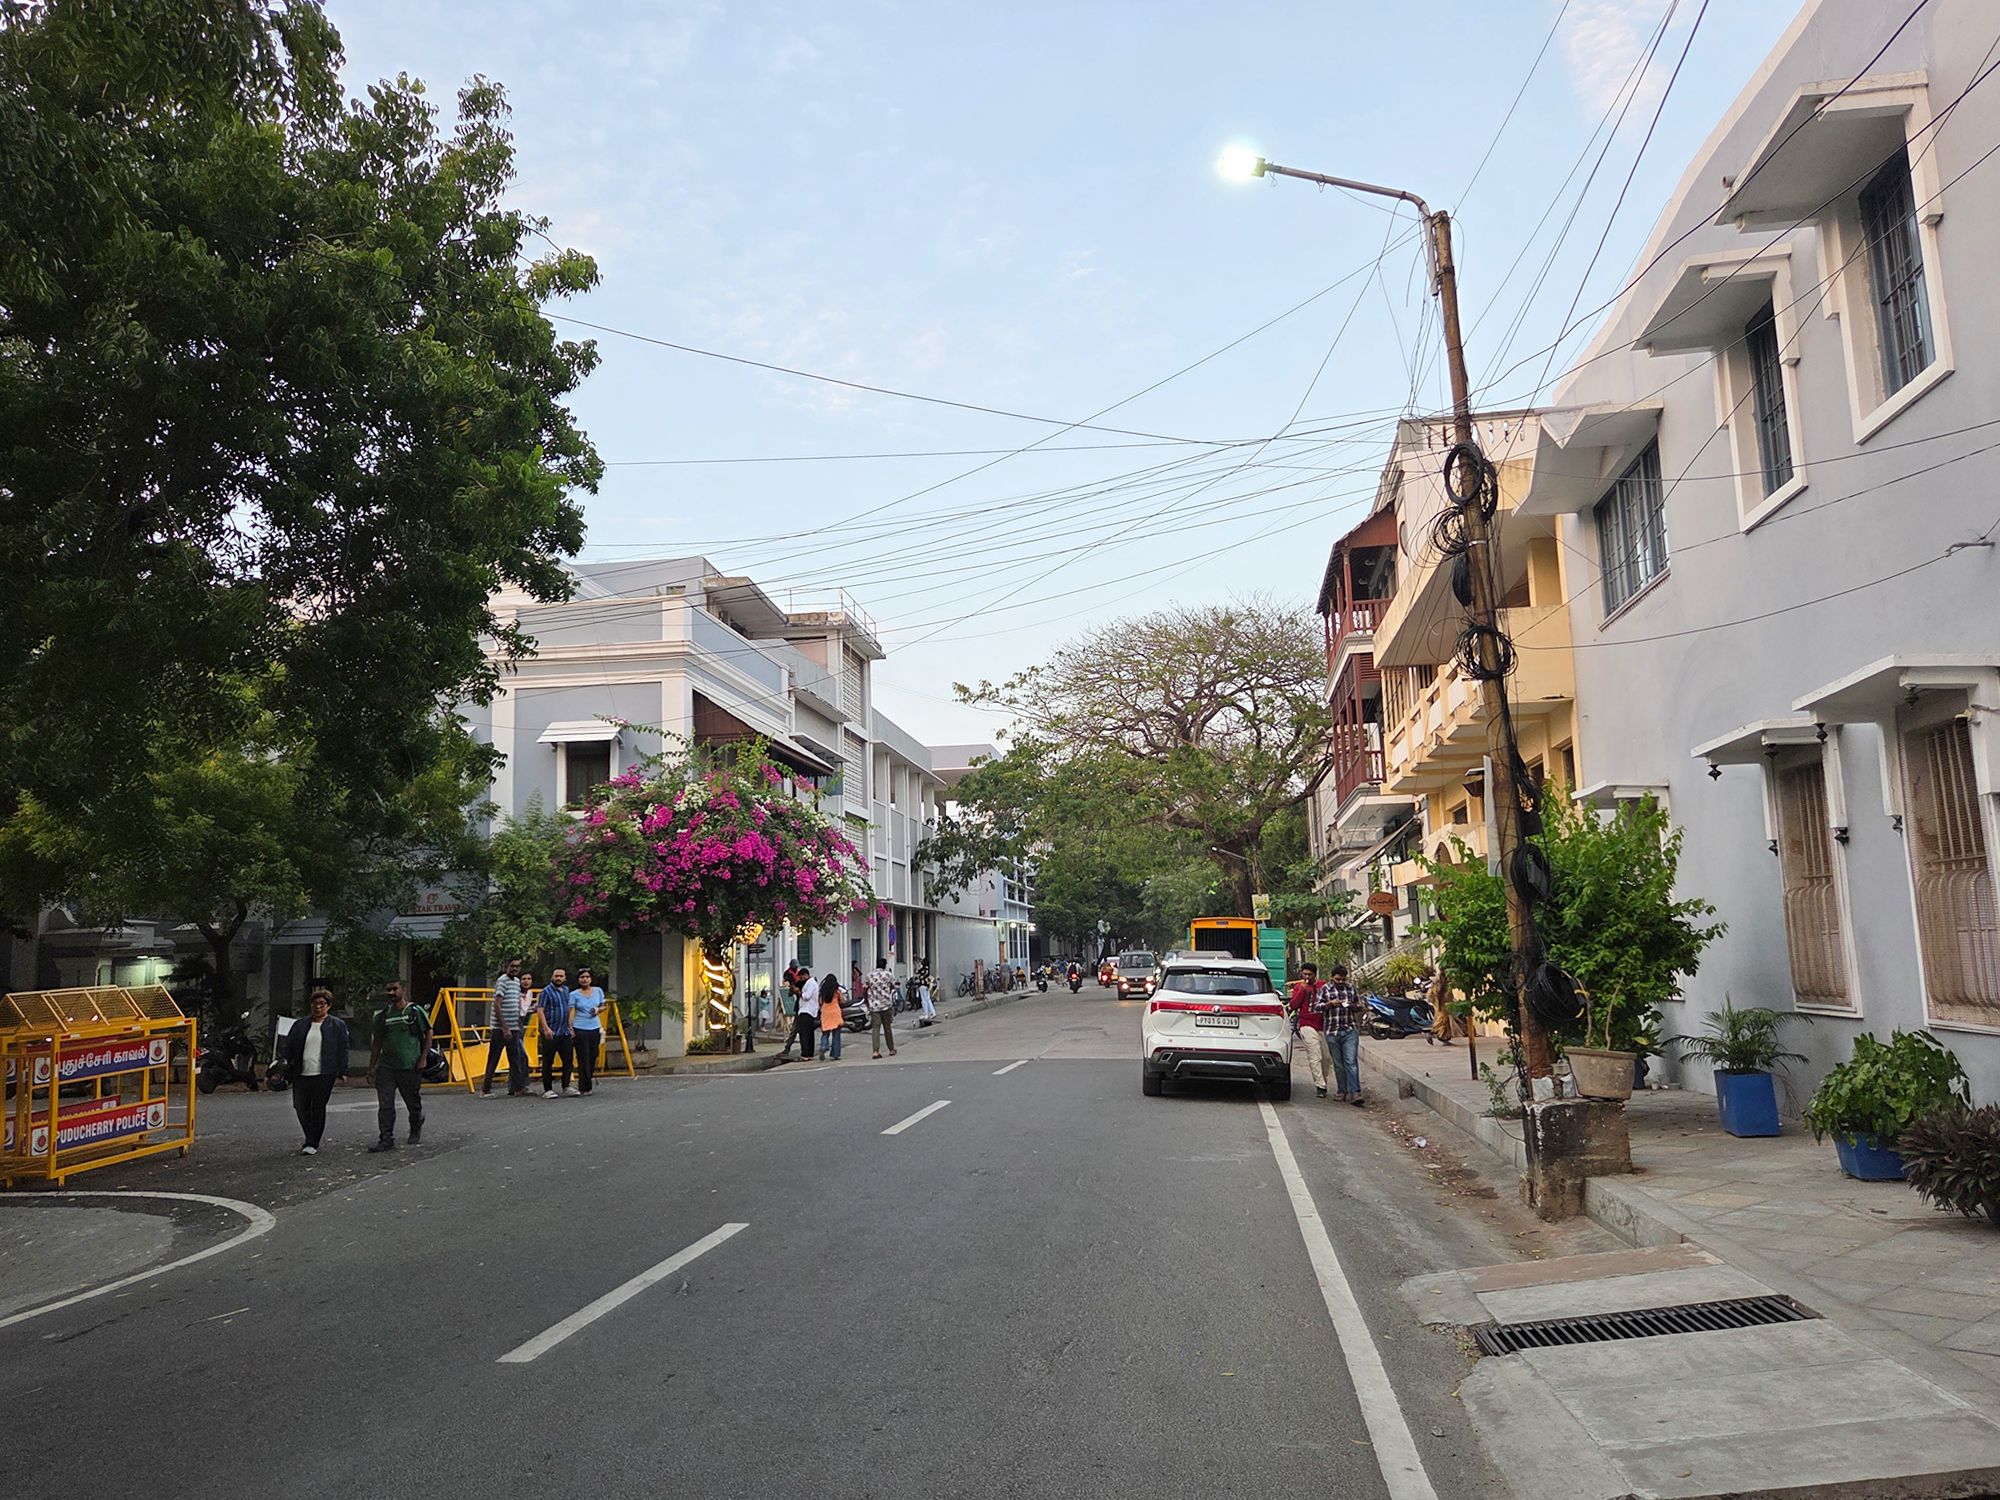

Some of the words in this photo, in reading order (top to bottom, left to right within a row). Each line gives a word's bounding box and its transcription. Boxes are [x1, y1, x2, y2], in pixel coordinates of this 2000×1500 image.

[58, 1050, 112, 1076] புதுச்சேரி
[113, 1046, 147, 1064] காவல்
[57, 1119, 115, 1143] PUDUCHERRY
[116, 1113, 146, 1131] POLICE
